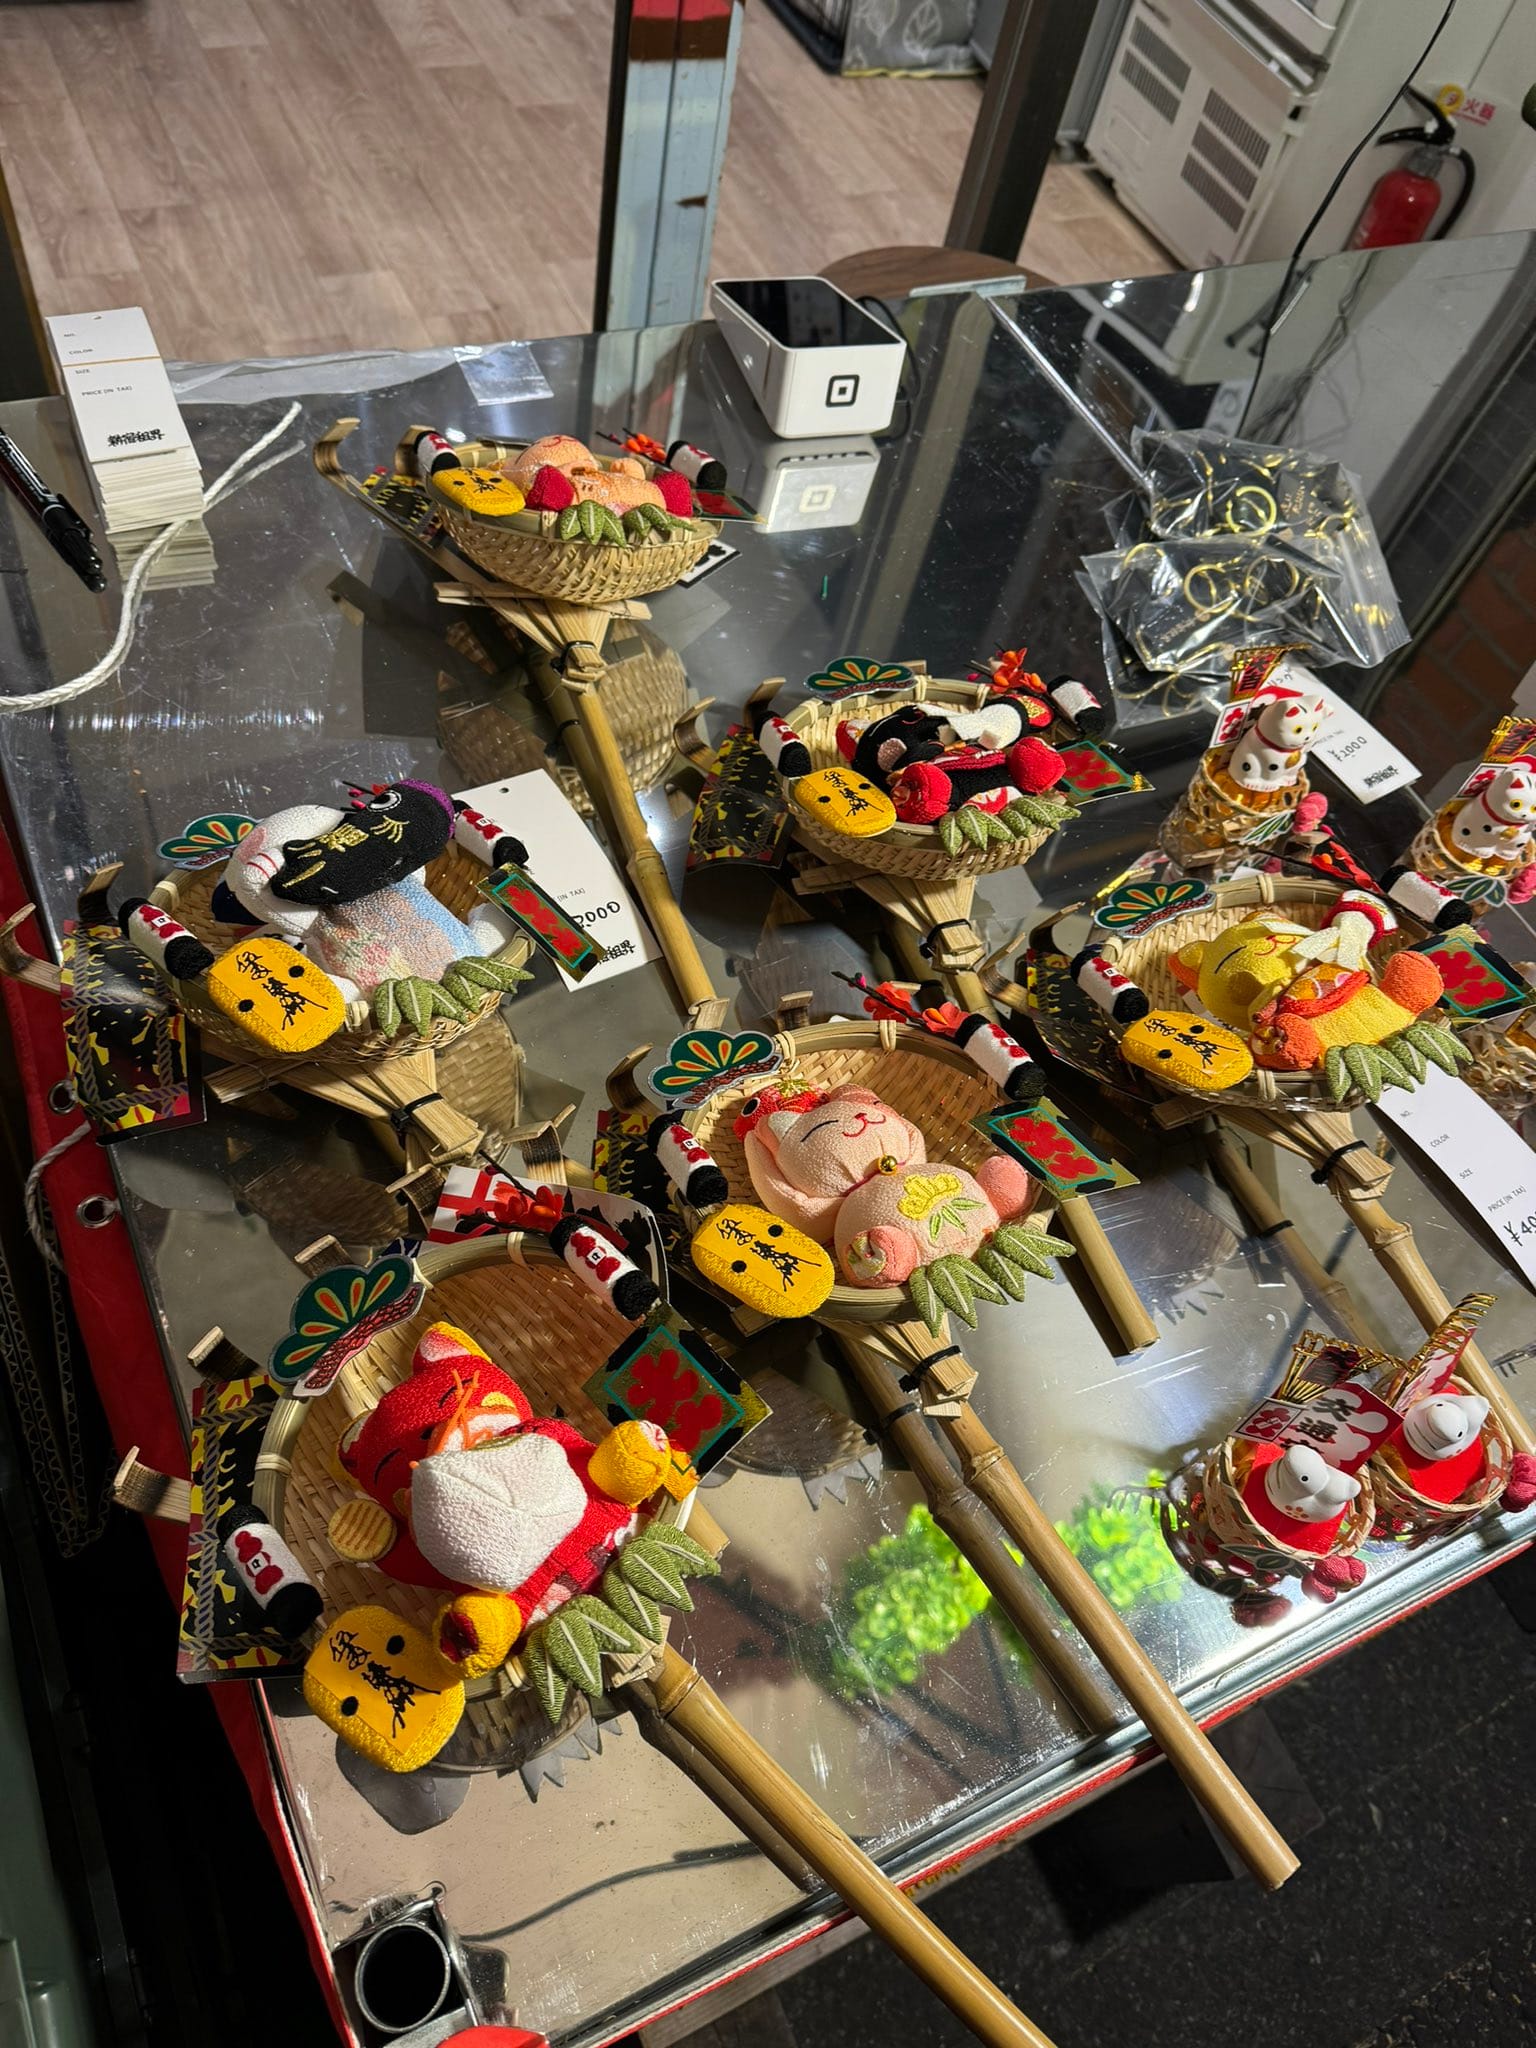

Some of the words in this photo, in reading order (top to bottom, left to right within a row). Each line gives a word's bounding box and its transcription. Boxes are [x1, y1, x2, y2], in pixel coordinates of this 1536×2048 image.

[81, 389, 102, 397] PRICE
[1429, 1133, 1450, 1148] COLOR
[1459, 1168, 1473, 1179] SIZE
[1487, 1199, 1505, 1213] PRICE
